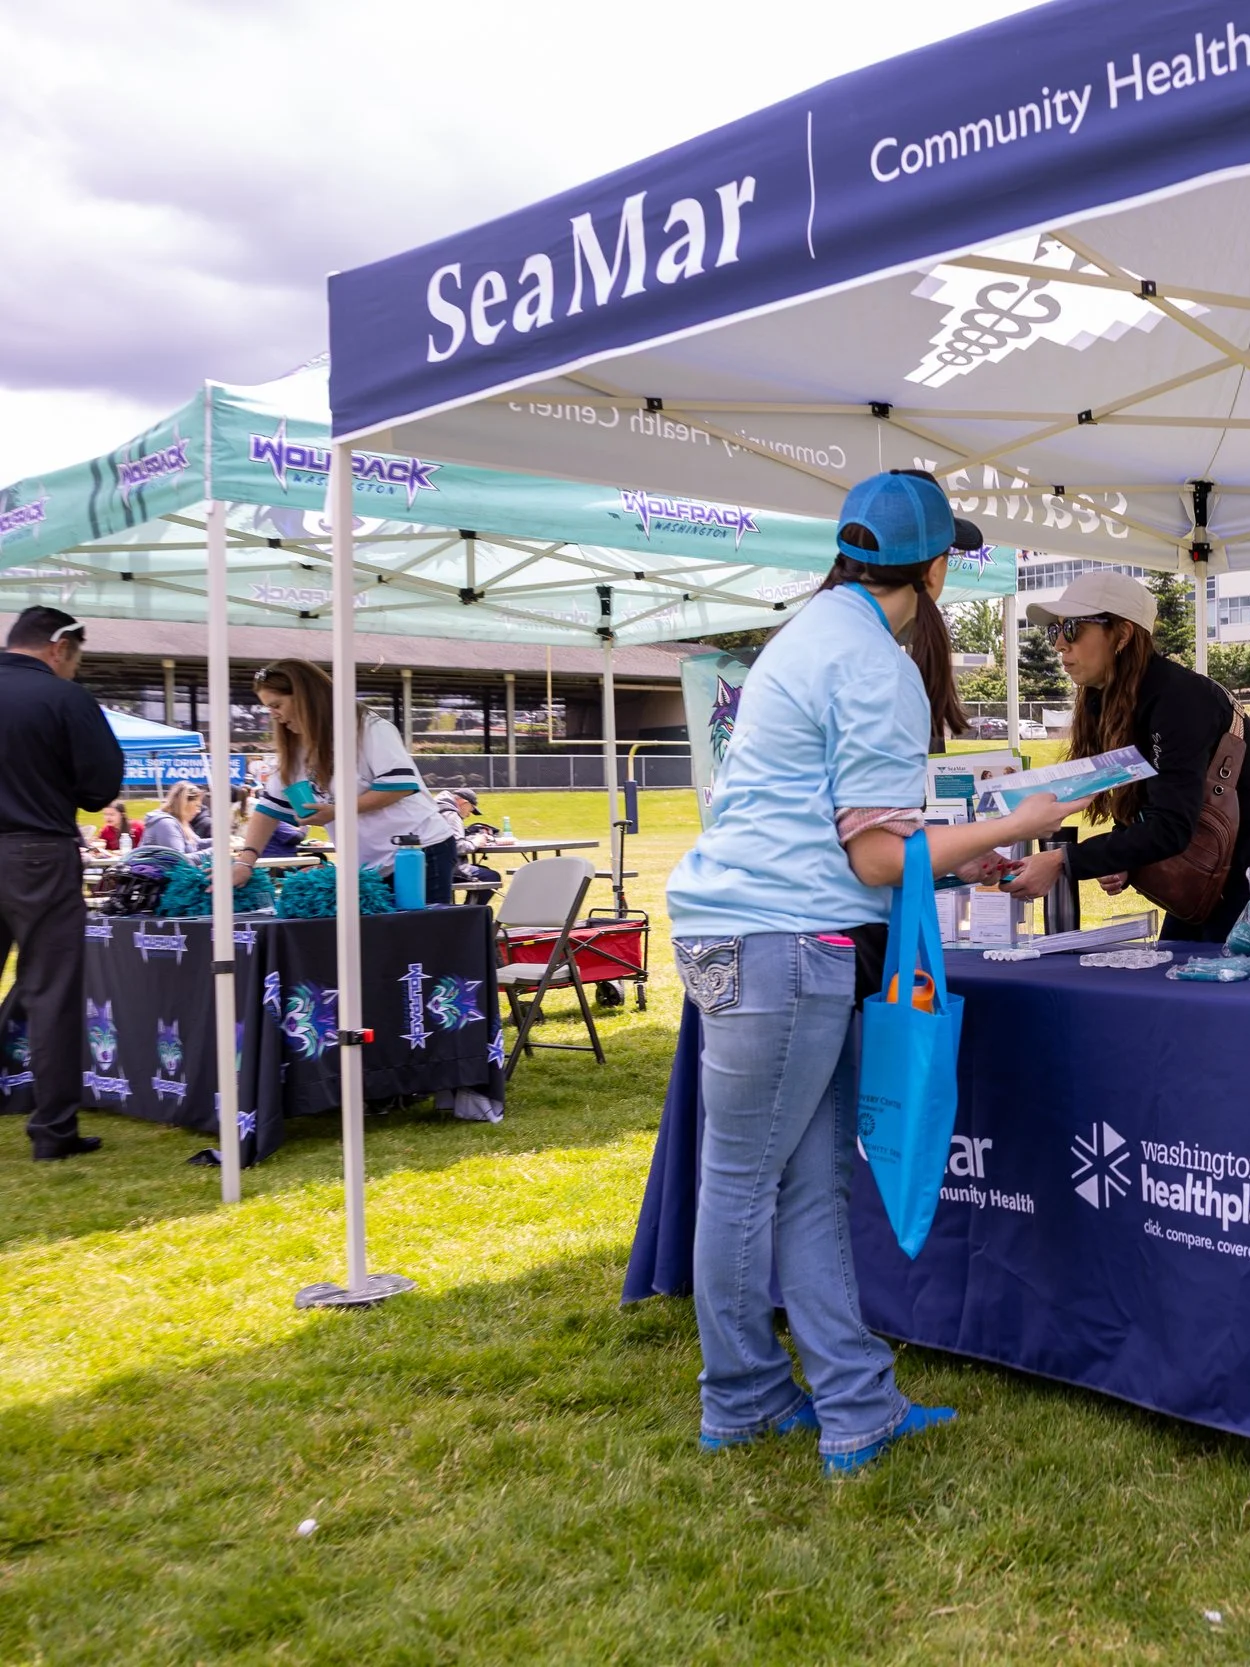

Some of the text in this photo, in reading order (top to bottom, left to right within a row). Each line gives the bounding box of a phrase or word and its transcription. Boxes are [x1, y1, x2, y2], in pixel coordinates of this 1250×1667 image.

[869, 84, 1092, 183] Community
[293, 474, 398, 495] WASGTON
[621, 490, 761, 543] WOLFPACK
[655, 521, 729, 539] WASHINGTON
[945, 1134, 993, 1178] ar
[989, 1189, 1035, 1214] Health
[1166, 1226, 1215, 1249] compare.
